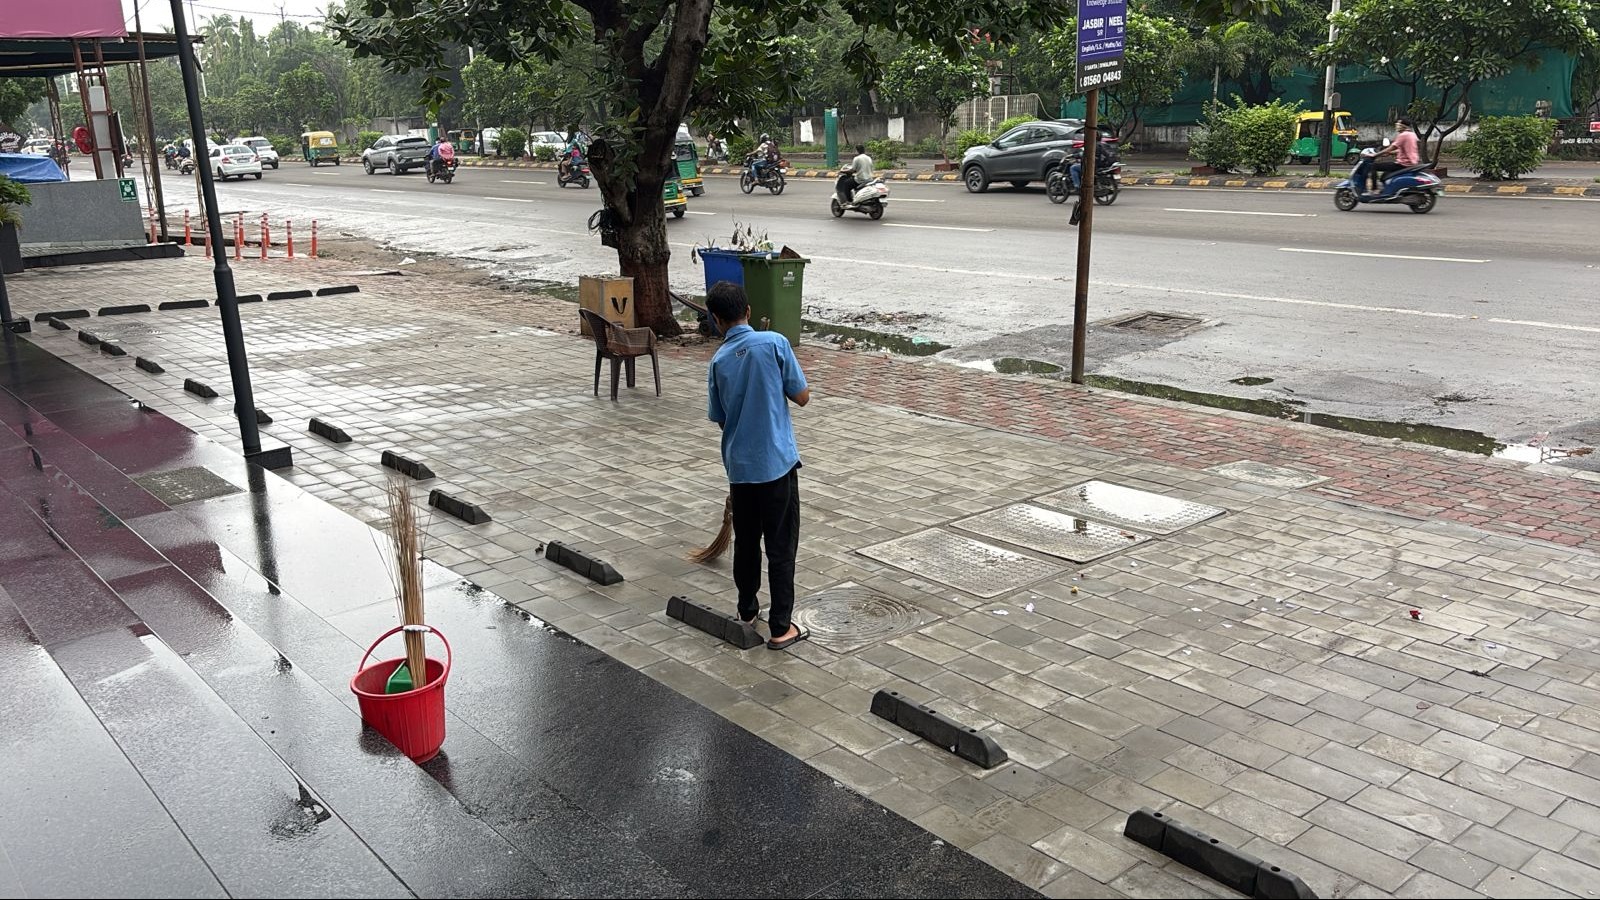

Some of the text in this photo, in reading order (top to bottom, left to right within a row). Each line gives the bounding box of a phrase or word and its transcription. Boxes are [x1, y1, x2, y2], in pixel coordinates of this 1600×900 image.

[1082, 18, 1103, 30] JASBIR
[1109, 16, 1123, 26] NEEL
[1083, 70, 1121, 86] 81560 04843
